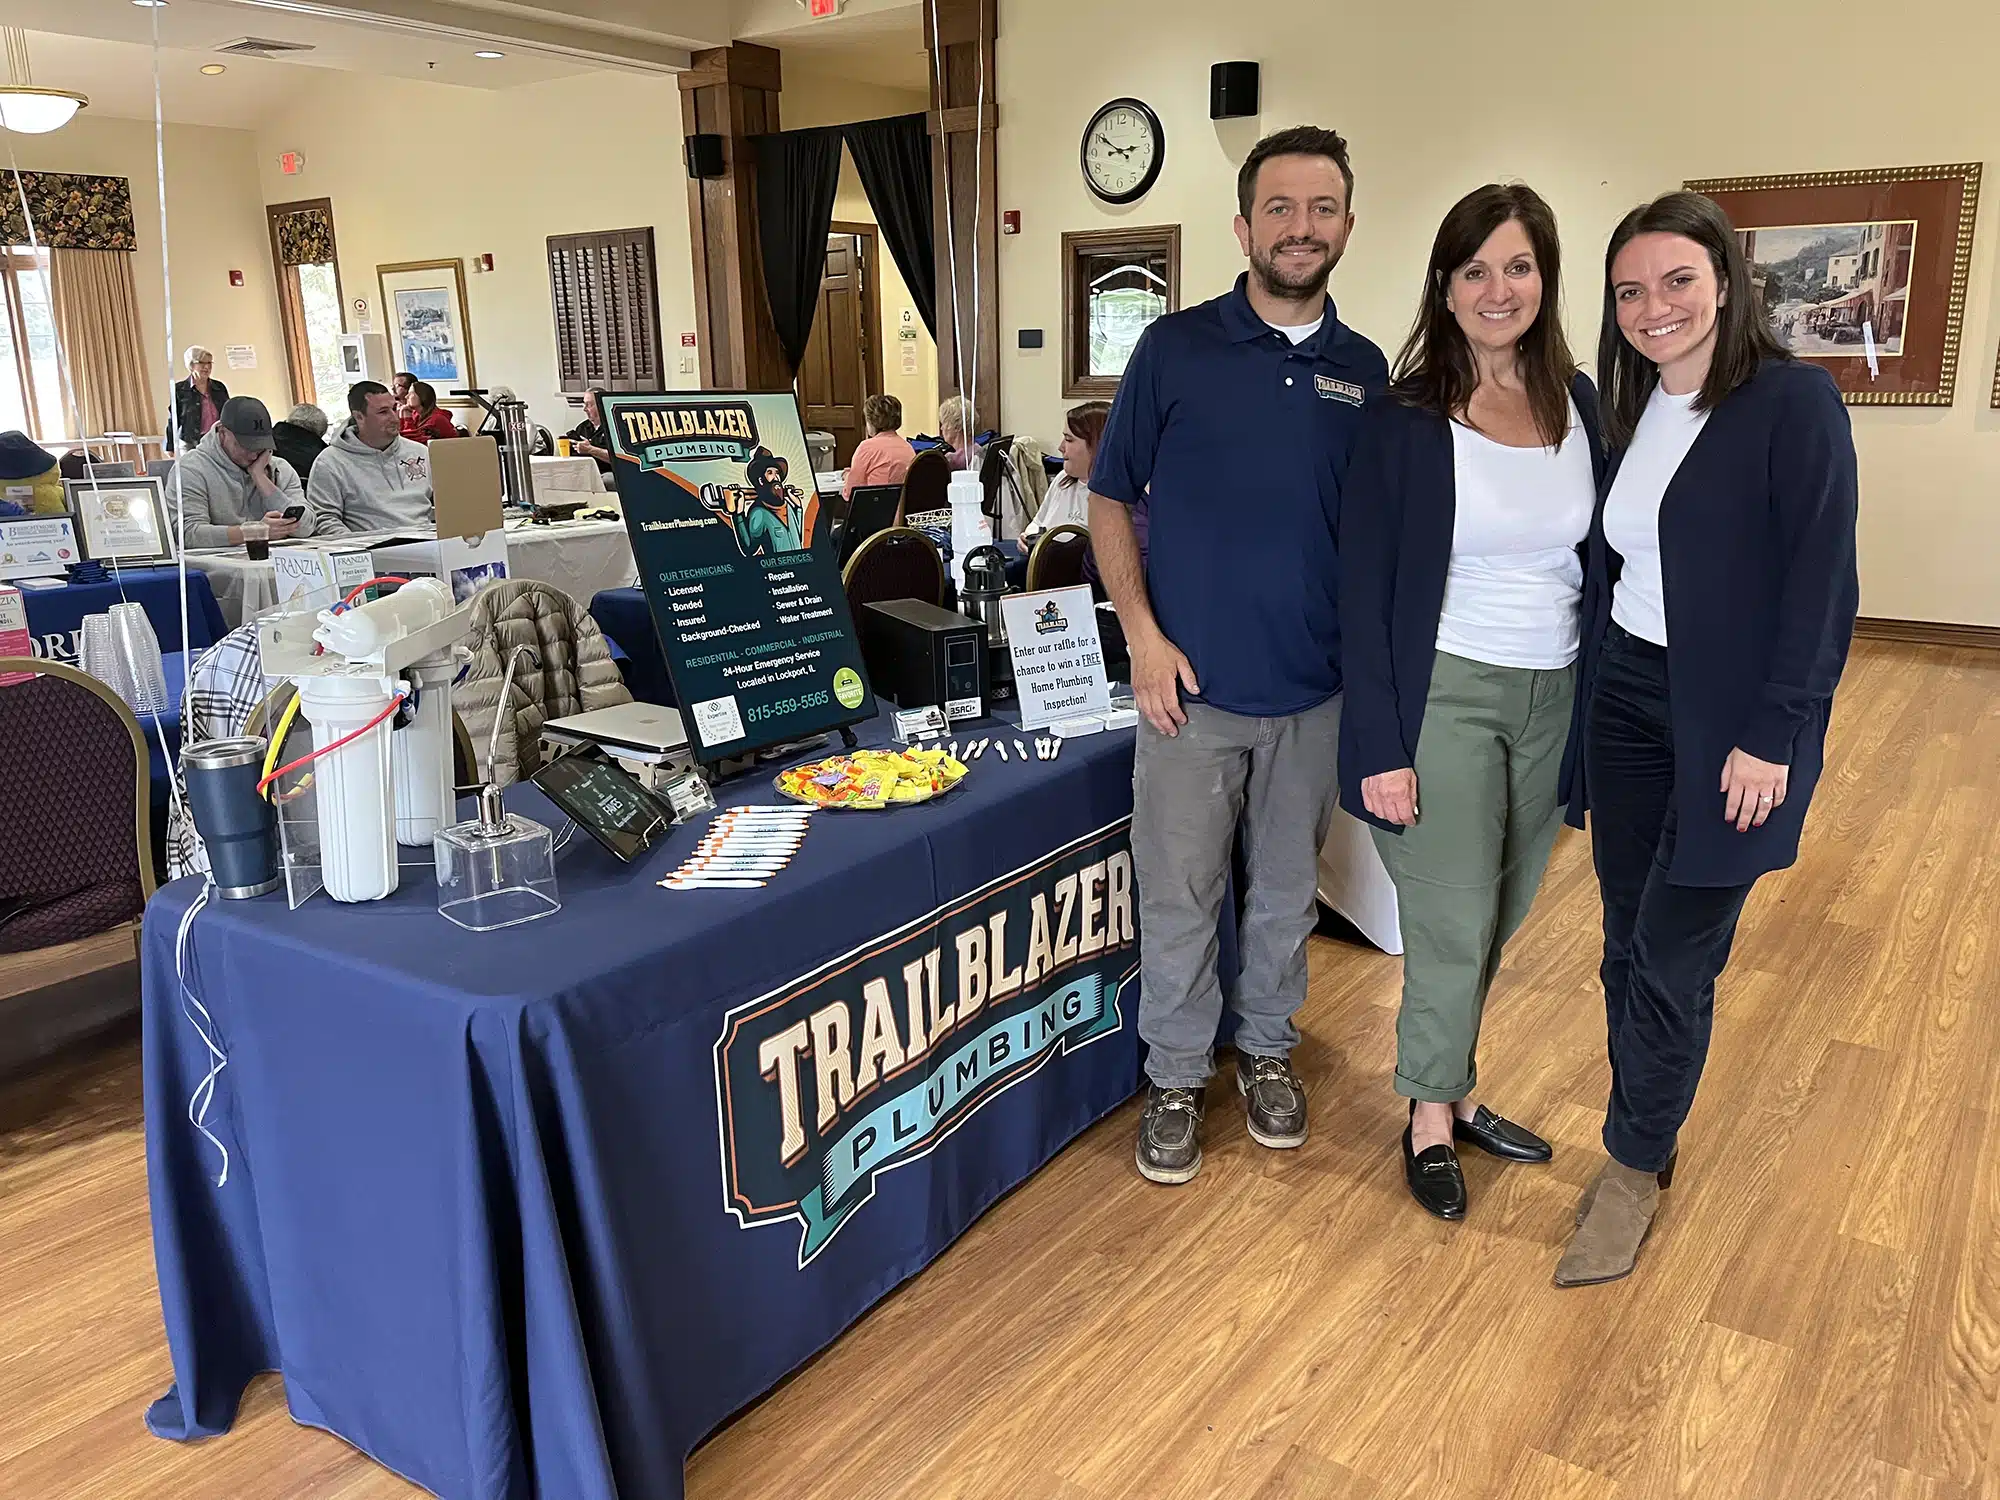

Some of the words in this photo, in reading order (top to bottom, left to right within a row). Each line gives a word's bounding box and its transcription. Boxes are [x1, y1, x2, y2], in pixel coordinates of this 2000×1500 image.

[1104, 119, 1113, 131] 11
[1116, 113, 1127, 125] 12
[1132, 116, 1136, 127] 1
[1140, 127, 1147, 138] 2
[1091, 147, 1098, 159] 9
[1143, 143, 1151, 155] 3
[1094, 163, 1101, 174] 8
[1140, 160, 1147, 170] 4
[1104, 174, 1110, 185] 7
[1116, 177, 1123, 188] 6
[1129, 172, 1137, 183] 5
[621, 409, 752, 444] TRAILBLAZER
[654, 443, 737, 458] PLUMBING
[641, 516, 718, 532] TrailblazerPlumbing.com
[274, 556, 323, 579] FRANZIA
[760, 557, 776, 568] OUR
[777, 553, 814, 566] SERVICES:
[659, 570, 678, 583] OUR
[679, 563, 735, 580] TECHNICIANS:
[768, 571, 795, 582] Repairs
[668, 584, 704, 597] Licensed
[771, 583, 809, 596] Installation
[673, 600, 703, 612] Bonded
[776, 600, 797, 610] Sewer
[798, 597, 804, 606] &
[805, 595, 823, 605] Drain
[677, 615, 707, 628] Insured
[779, 614, 800, 625] Water
[801, 607, 834, 620] Treatment
[681, 620, 761, 643] Background-Checked
[686, 650, 739, 669] RESIDENTIAL
[745, 639, 797, 657] COMMERCIAL
[802, 629, 845, 645] INDUSTRIAL
[1014, 646, 1036, 658] Enter
[1038, 644, 1052, 654] our
[1054, 638, 1076, 651] raffle
[1077, 636, 1089, 647] for
[1091, 637, 1097, 645] a
[722, 664, 753, 677] 24-Hour
[754, 656, 794, 672] Emergency
[795, 649, 821, 662] Service
[1016, 663, 1046, 677] chance
[1047, 661, 1056, 672] to
[1057, 657, 1074, 669] win
[1075, 659, 1080, 667] a
[1081, 652, 1102, 667] FREE
[737, 676, 767, 690] Located
[768, 674, 775, 683] in
[776, 667, 808, 682] Lockport,
[808, 664, 816, 674] IL
[1031, 680, 1055, 694] Home
[1055, 675, 1094, 690] Plumbing
[748, 690, 829, 723] 815-559-5565
[1043, 692, 1088, 711] Inspection!
[758, 850, 1135, 1164] TRAILBLAZER
[851, 989, 1083, 1172] PLUMBING
